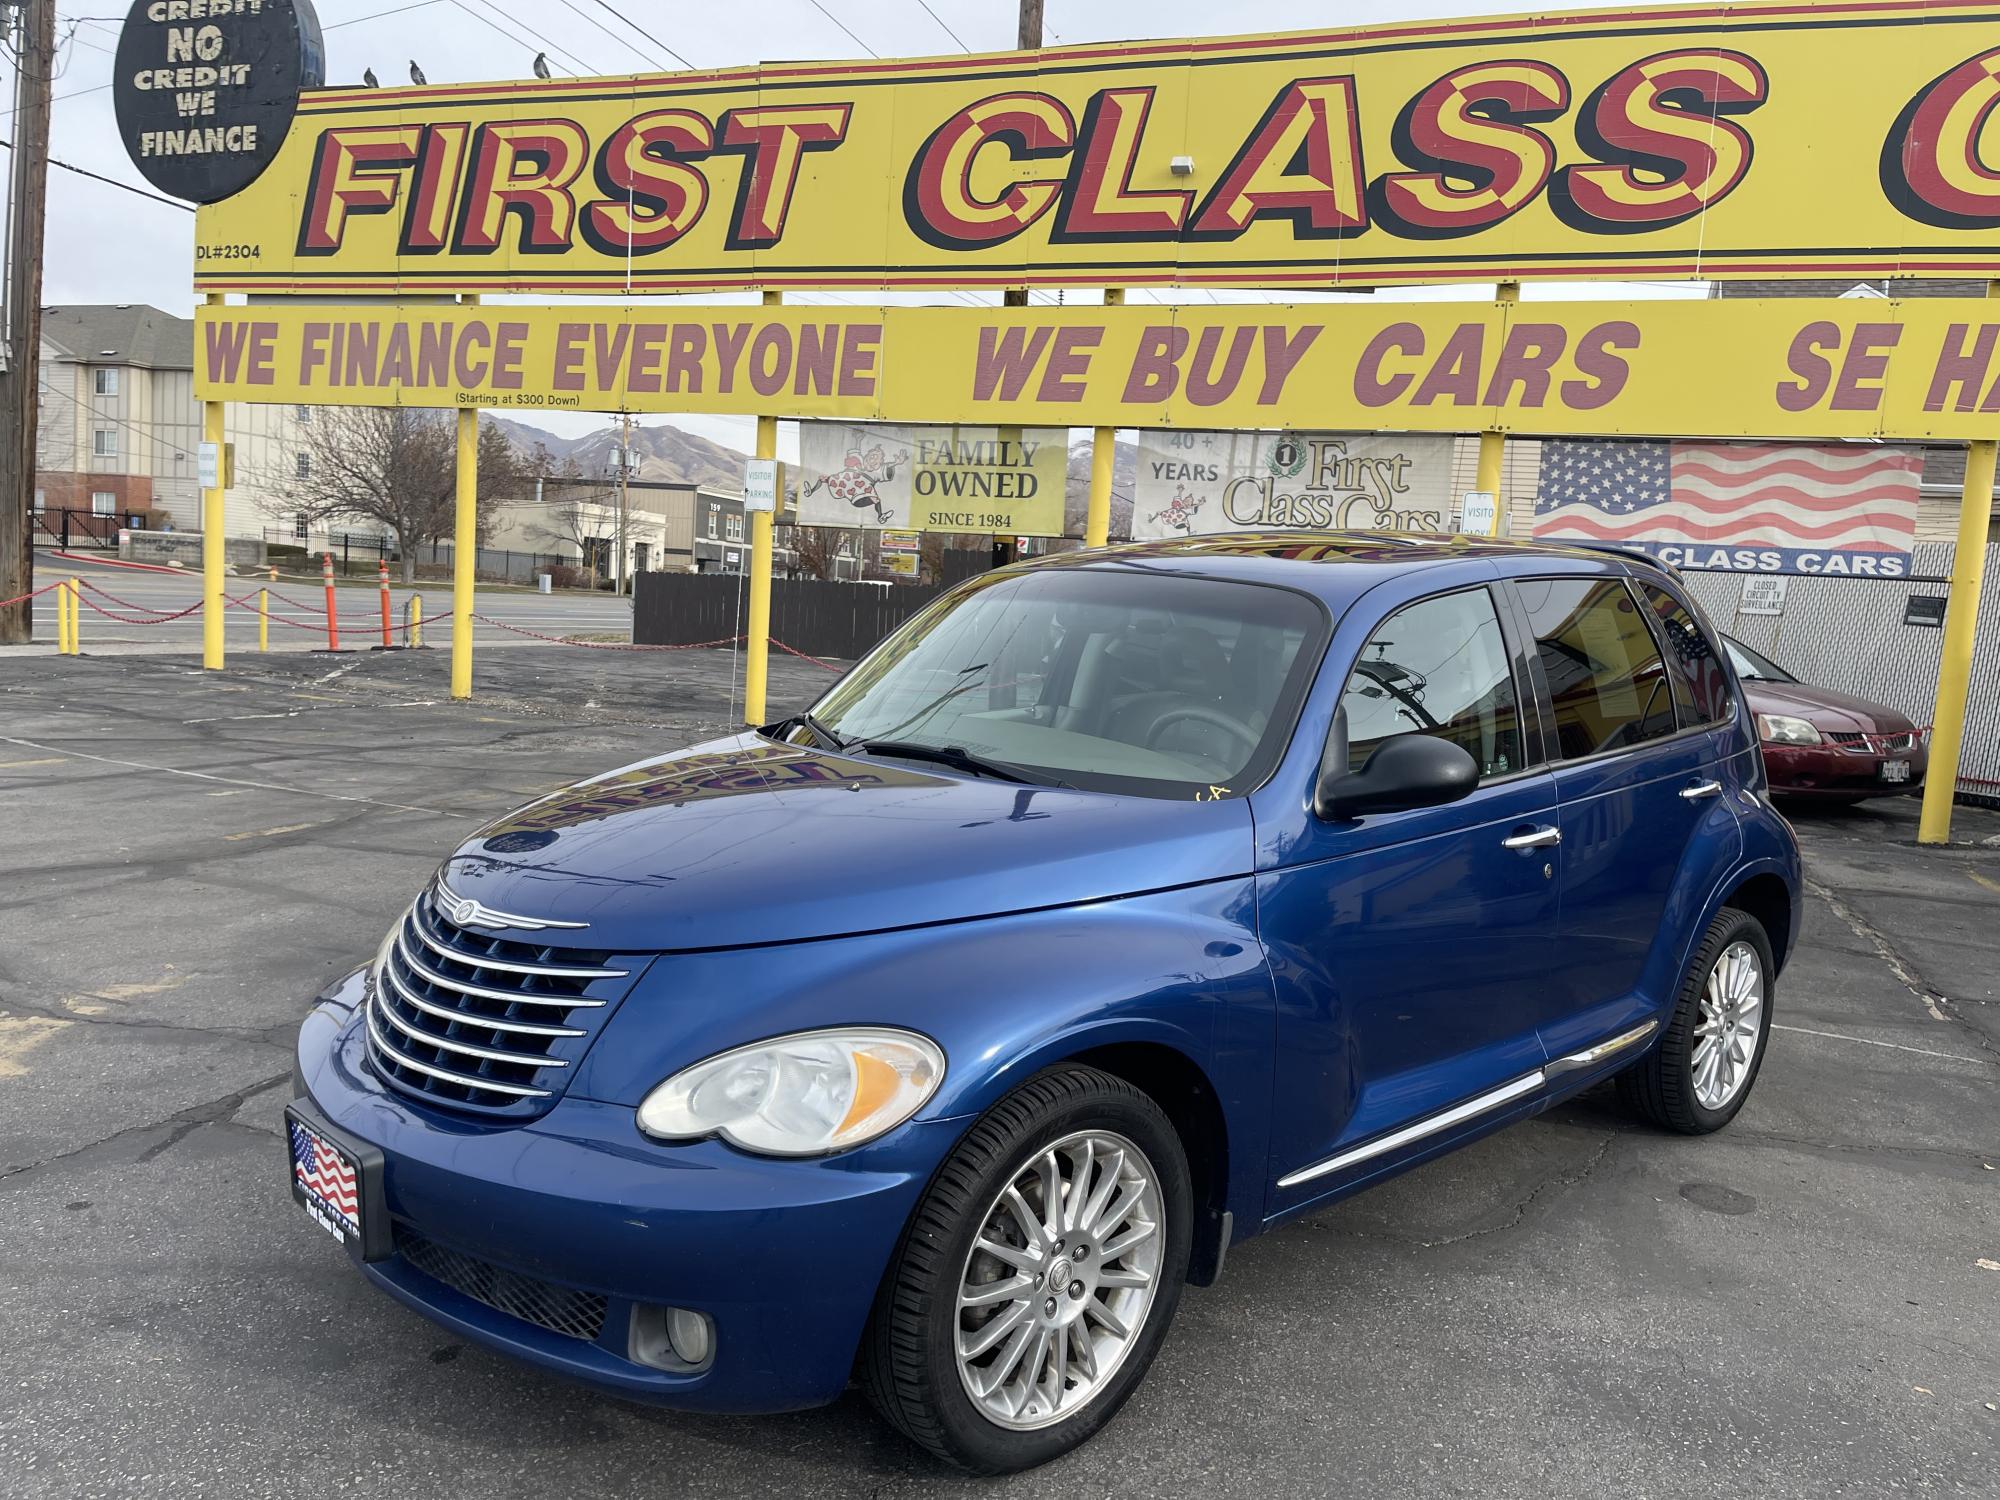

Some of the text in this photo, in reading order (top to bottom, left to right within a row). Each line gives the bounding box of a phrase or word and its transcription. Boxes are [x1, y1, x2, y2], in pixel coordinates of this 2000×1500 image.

[146, 0, 262, 22] CREDIT
[166, 25, 223, 63] NO
[133, 64, 251, 90] CREDIT
[176, 90, 215, 117] WE
[140, 125, 257, 157] FINANCE
[295, 102, 854, 257] FIRST
[903, 48, 1769, 252] CLASS
[196, 245, 260, 259] DL#2304
[205, 321, 278, 385] WE
[300, 321, 529, 391] FINANCE
[552, 321, 882, 397] EVERYONE
[972, 325, 1105, 403] WE
[1120, 325, 1325, 407] BUY
[1353, 321, 1641, 410] CARS
[1775, 321, 1904, 412] SE
[455, 392, 580, 406] (Starting at $300 Down)
[916, 439, 1041, 468] FAMILY
[1170, 433, 1194, 449] 40
[748, 471, 772, 481] VISITOR
[915, 470, 1039, 498] OWNED
[1151, 462, 1218, 482] YEARS
[1306, 440, 1412, 512] First
[1222, 476, 1440, 530] Class Cars
[1468, 507, 1493, 518] VISITO
[929, 512, 1012, 528] SINCE 1984
[1657, 547, 1904, 577] CLASS CARS
[1746, 589, 1769, 600] CIRCUIT
[1754, 580, 1777, 590] CLOSED
